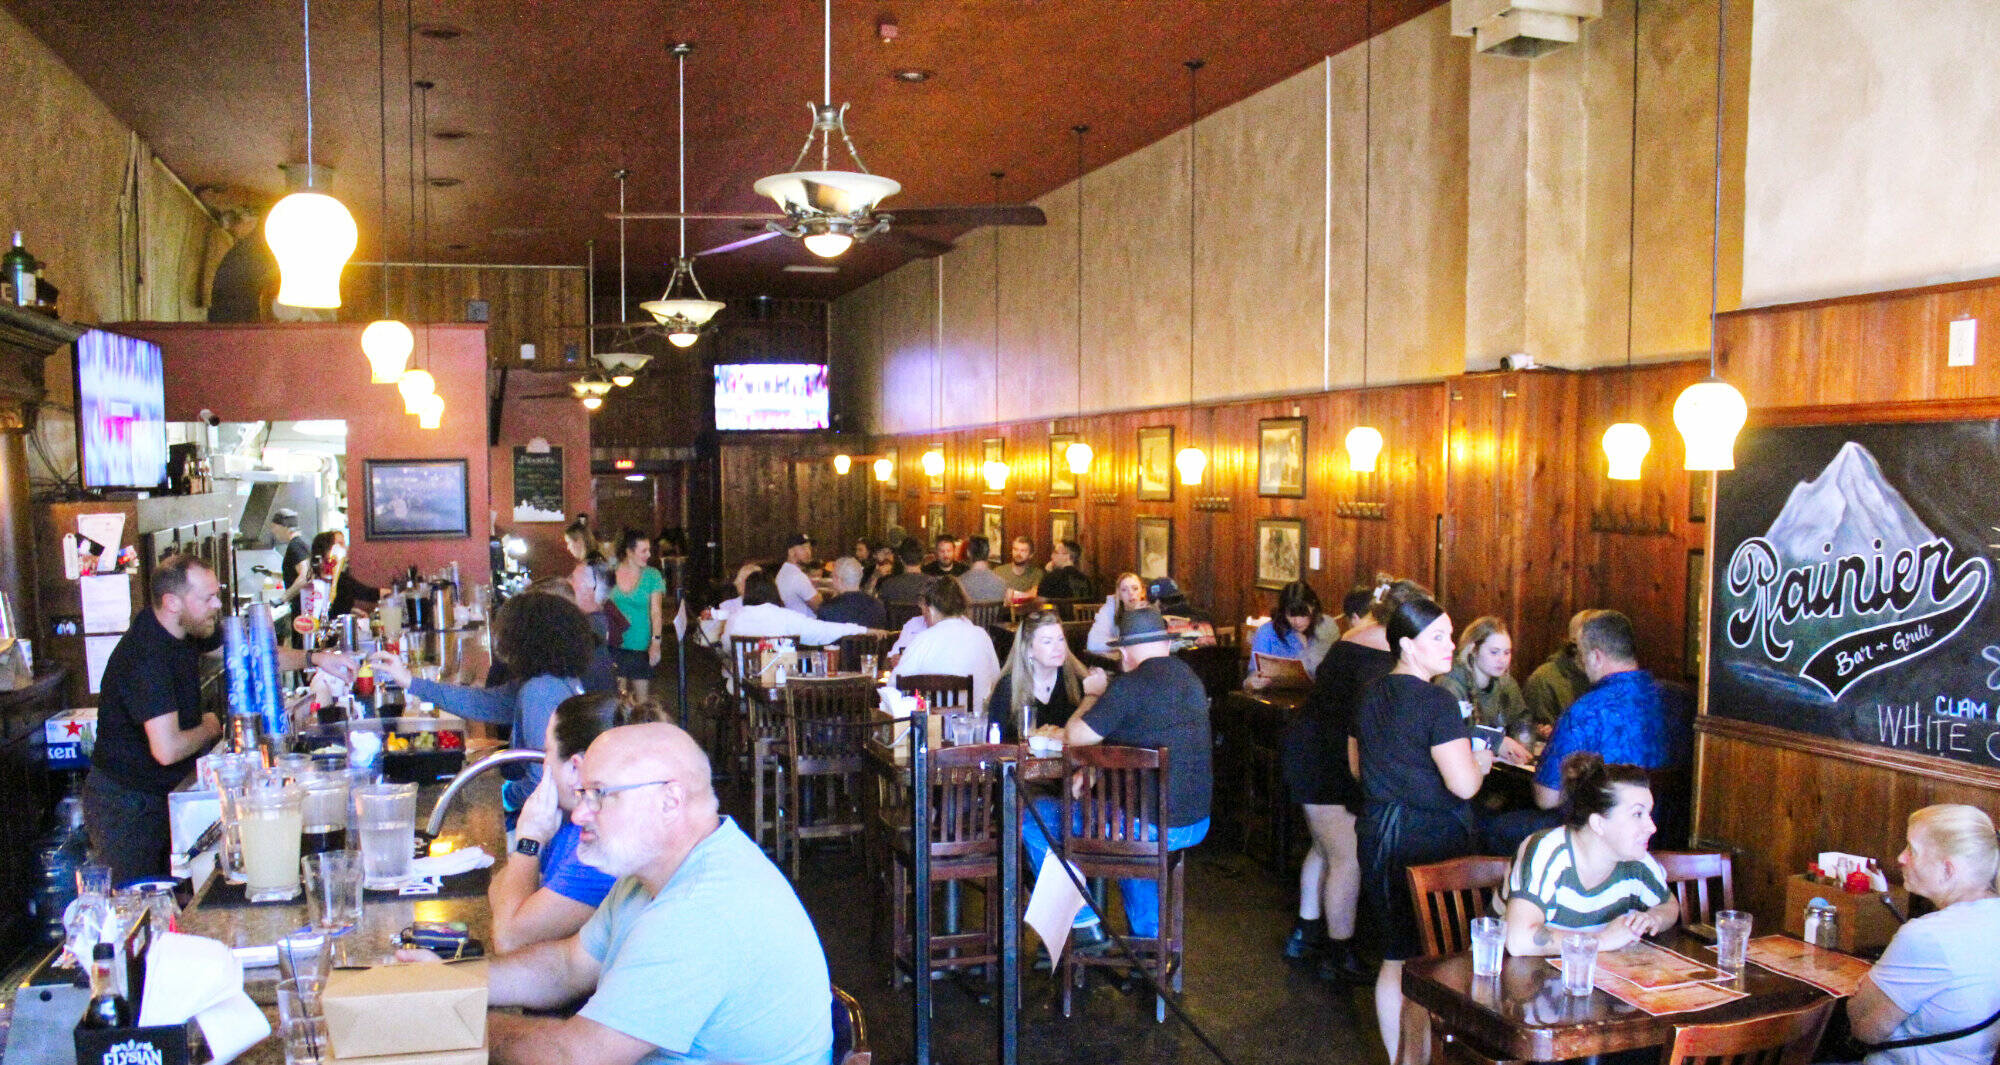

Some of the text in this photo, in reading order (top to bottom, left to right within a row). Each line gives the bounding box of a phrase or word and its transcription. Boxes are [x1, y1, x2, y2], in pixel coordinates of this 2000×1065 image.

[1728, 537, 1989, 661] Rainier
[1835, 645, 1873, 676] Bar
[1892, 623, 1935, 652] Grill
[1877, 701, 1971, 752] WHITE
[1935, 695, 1987, 720] CLAM
